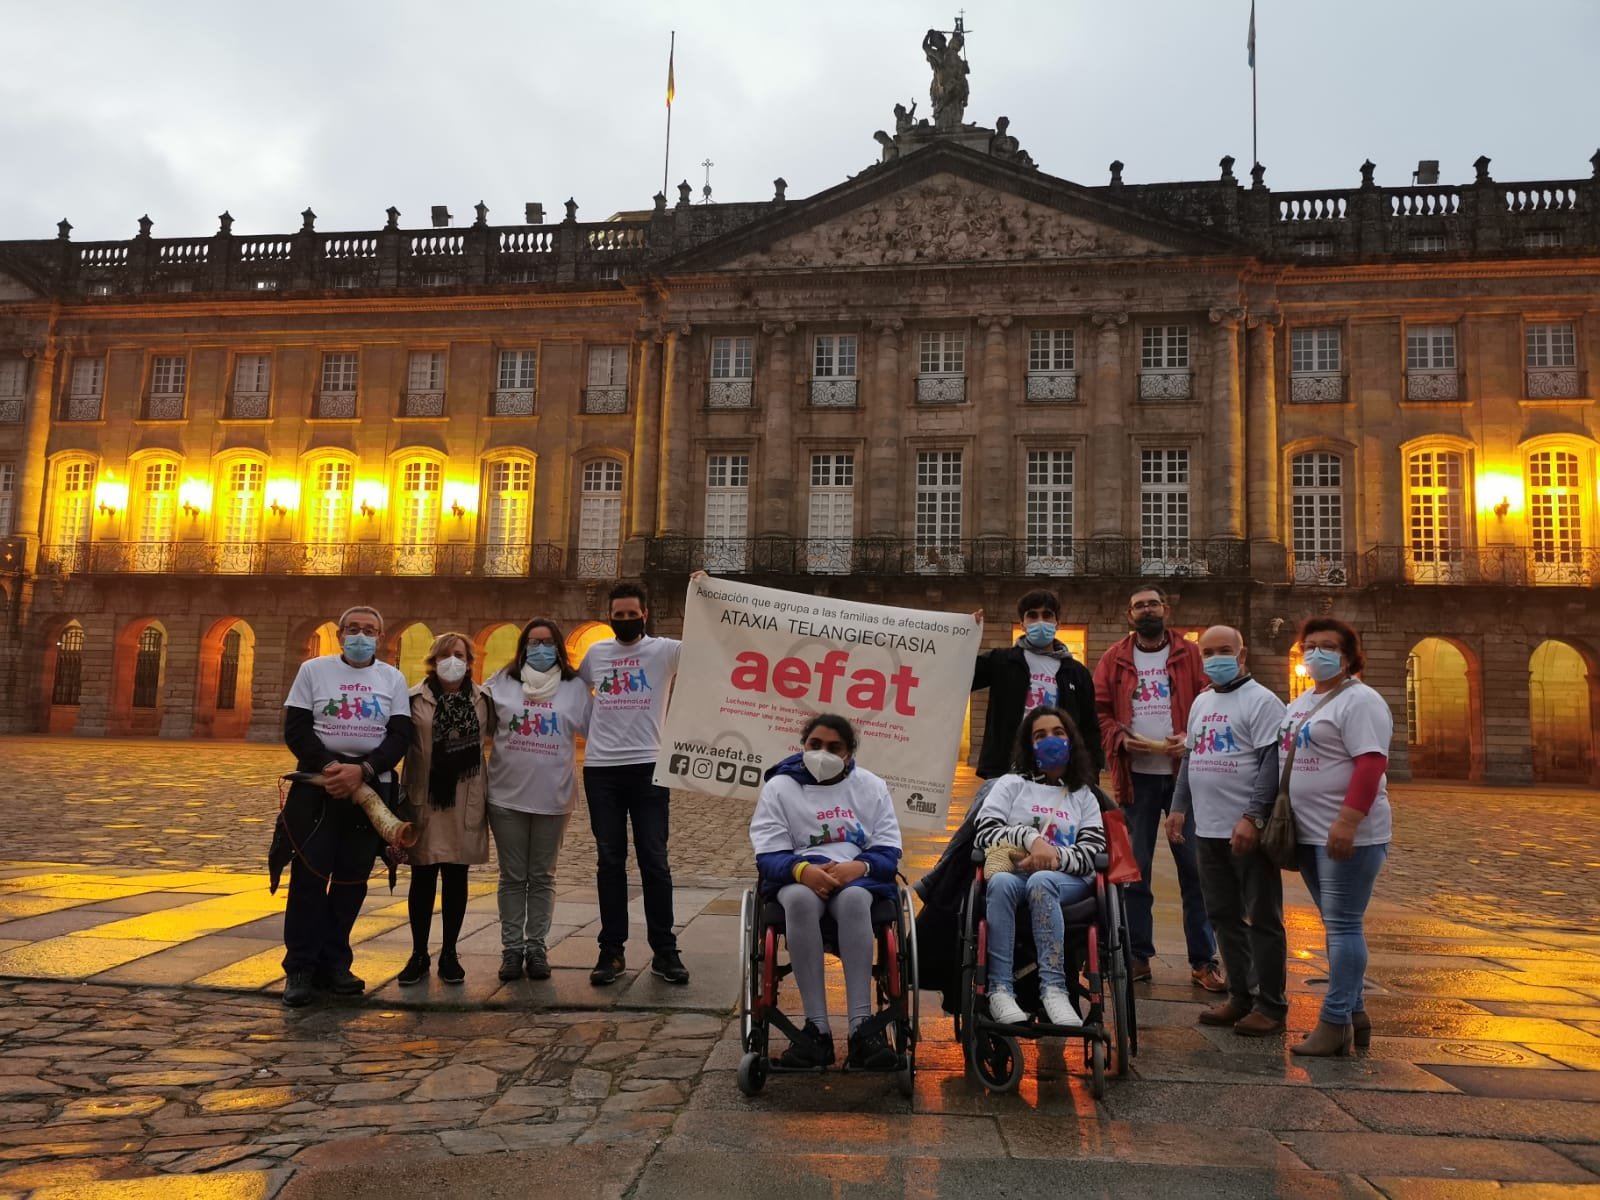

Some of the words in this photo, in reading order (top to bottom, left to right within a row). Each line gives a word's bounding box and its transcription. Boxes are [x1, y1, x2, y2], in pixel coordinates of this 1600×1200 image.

[696, 587, 749, 604] Asociación
[751, 597, 771, 608] que
[774, 600, 810, 614] agrupa
[812, 607, 819, 615] a
[822, 608, 837, 618] las
[840, 609, 879, 624] familias
[882, 615, 896, 625] de
[898, 617, 950, 633] afectados
[952, 626, 971, 637] por
[720, 609, 778, 631] ATAXIA
[788, 618, 936, 654] TELANGIECTASIA
[730, 650, 920, 716] aefat
[726, 696, 756, 707] Luchamos
[780, 705, 820, 717] investigació
[673, 740, 763, 764] www.aefat.es
[816, 806, 855, 820] aefat
